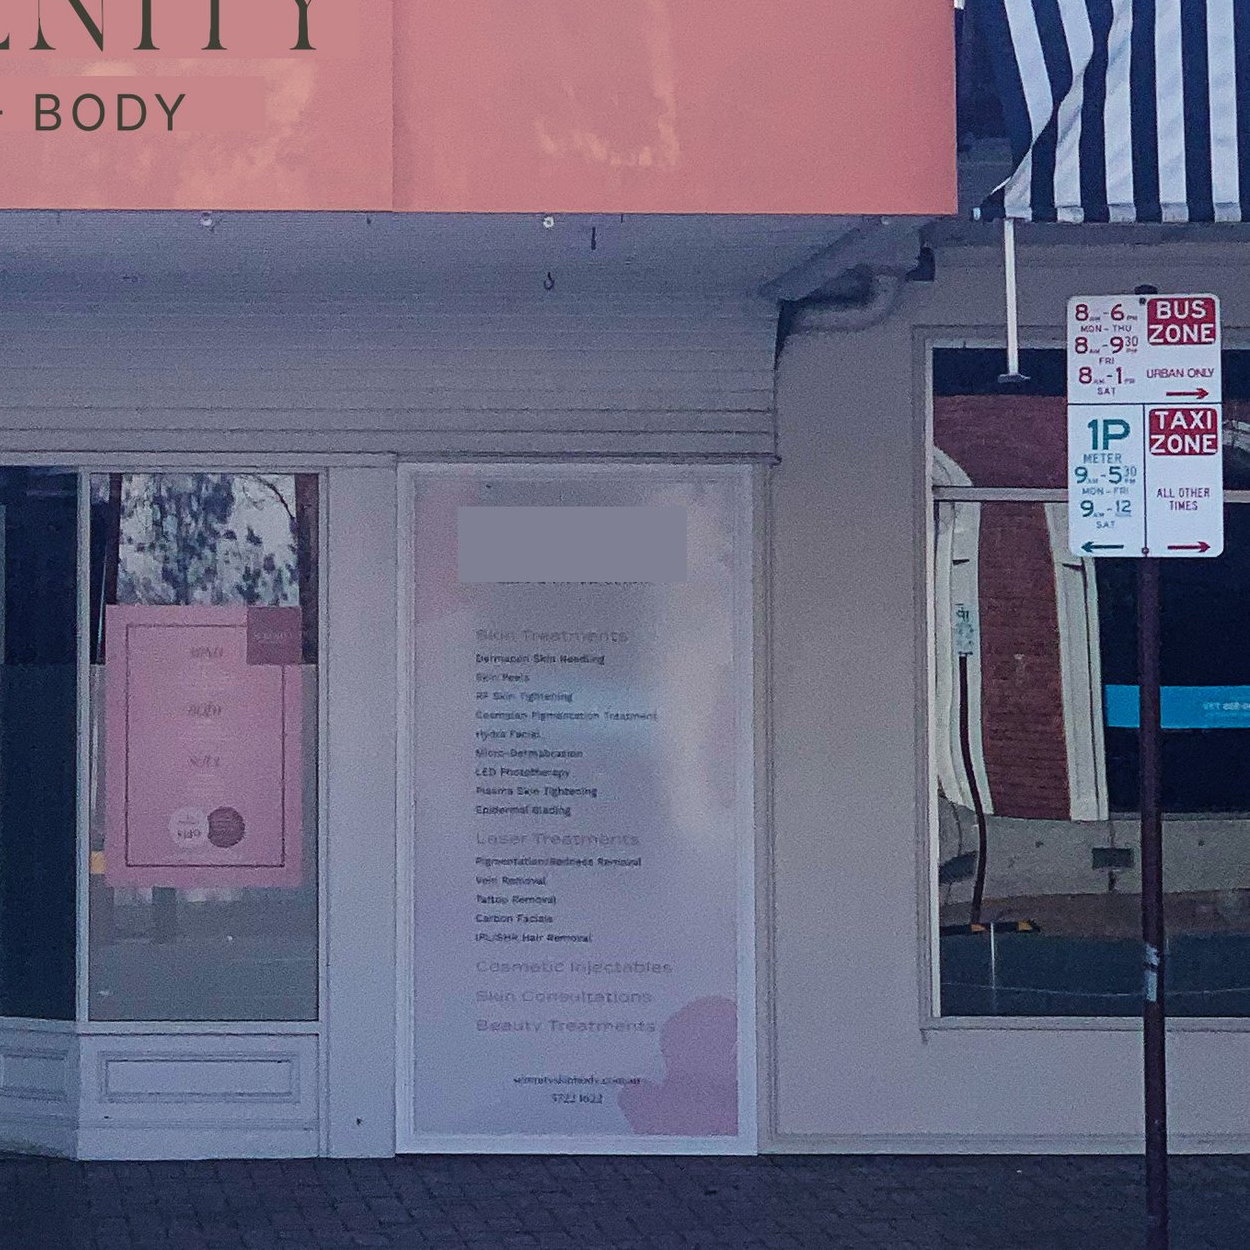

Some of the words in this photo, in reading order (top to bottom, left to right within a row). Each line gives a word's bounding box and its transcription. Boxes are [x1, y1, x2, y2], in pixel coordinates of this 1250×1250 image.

[34, 93, 187, 132] BODY
[1156, 300, 1207, 320] BUS
[1149, 323, 1215, 343] ZONE
[1099, 357, 1115, 365] FRI
[1146, 368, 1184, 379] URBAN
[1187, 368, 1215, 378] ONLY
[1097, 387, 1116, 396] SAT
[1154, 411, 1213, 430] TAXI
[1087, 419, 1131, 451] 1P
[1150, 435, 1217, 454] ZONE
[1083, 453, 1122, 464] METER
[1156, 488, 1175, 498] ALL
[1178, 488, 1210, 497] OTHER
[1169, 500, 1198, 511] TIMES
[1096, 521, 1116, 529] SAT
[533, 654, 556, 664] Skin
[493, 692, 517, 700] Skin
[476, 768, 497, 777] LED
[502, 877, 546, 885] Removal
[512, 895, 556, 904] Removal
[522, 934, 543, 942] Hair
[547, 934, 592, 942] Removal
[476, 1020, 541, 1033] Beauty
[549, 1020, 656, 1032] Treatments
